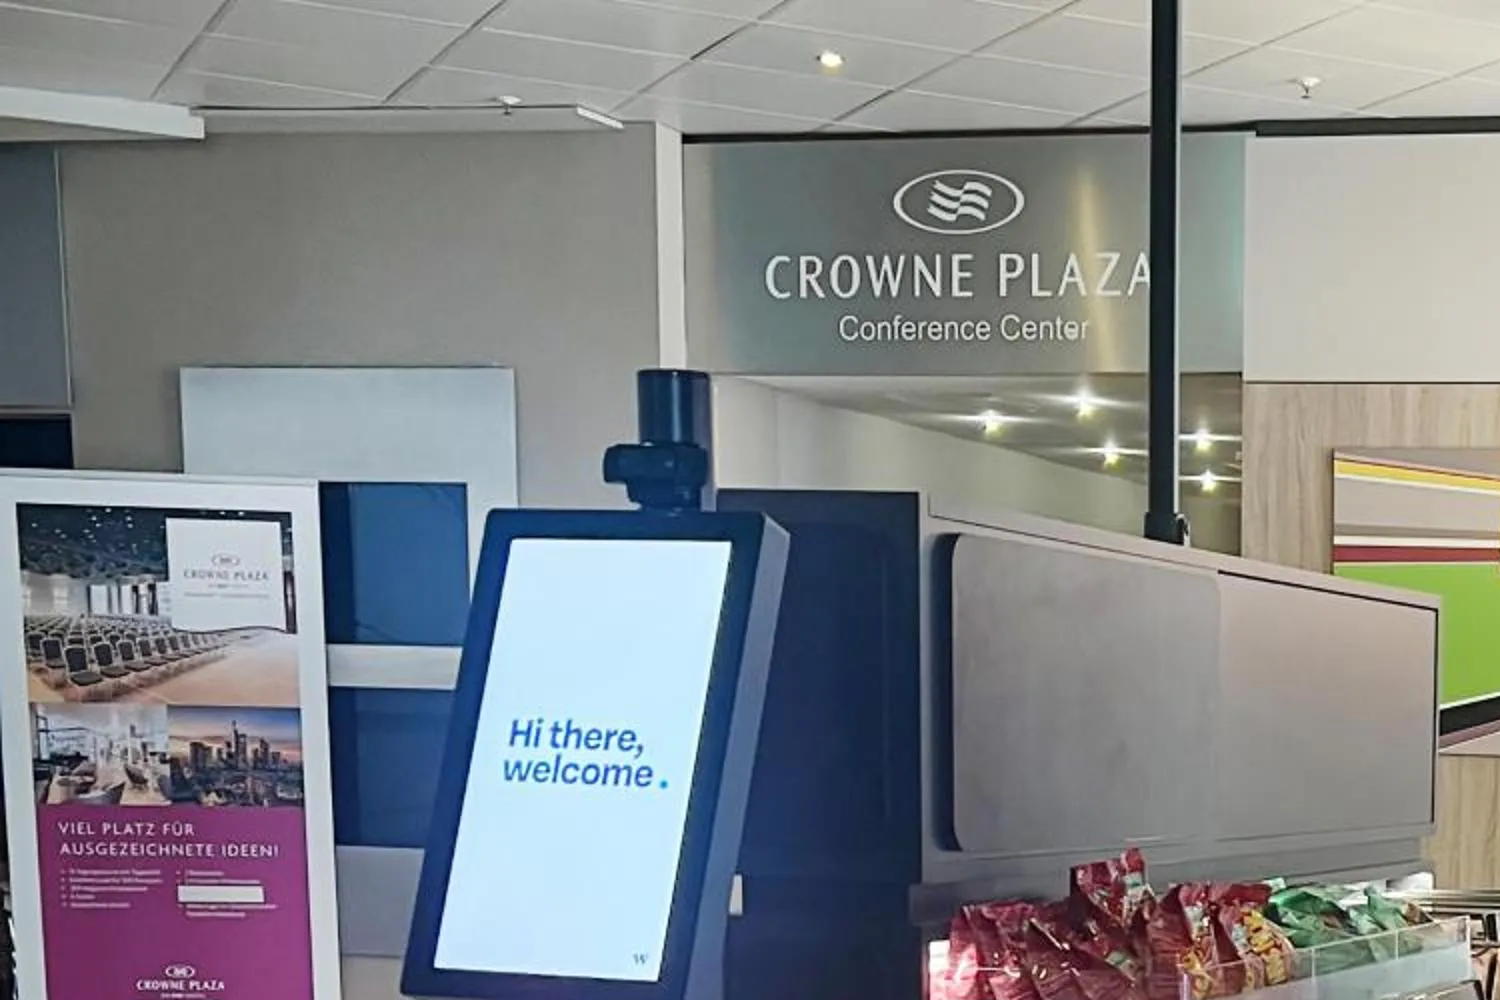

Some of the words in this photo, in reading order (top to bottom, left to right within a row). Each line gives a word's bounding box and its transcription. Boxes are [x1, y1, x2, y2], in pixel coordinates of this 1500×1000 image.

[765, 253, 974, 299] CROWNE
[999, 251, 1151, 298] PLAZA
[839, 314, 991, 342] Conference
[1001, 313, 1090, 341] Center
[509, 718, 545, 749] Hi
[550, 719, 644, 758] there,
[57, 822, 95, 836] VIEL
[102, 822, 156, 836] PLATZ
[163, 820, 195, 837] FÜR
[59, 842, 215, 857] AUSGEZEICHNETE
[221, 843, 279, 858] IDEEN!
[136, 979, 185, 991] CROWNE
[189, 980, 225, 991] PLAZA
